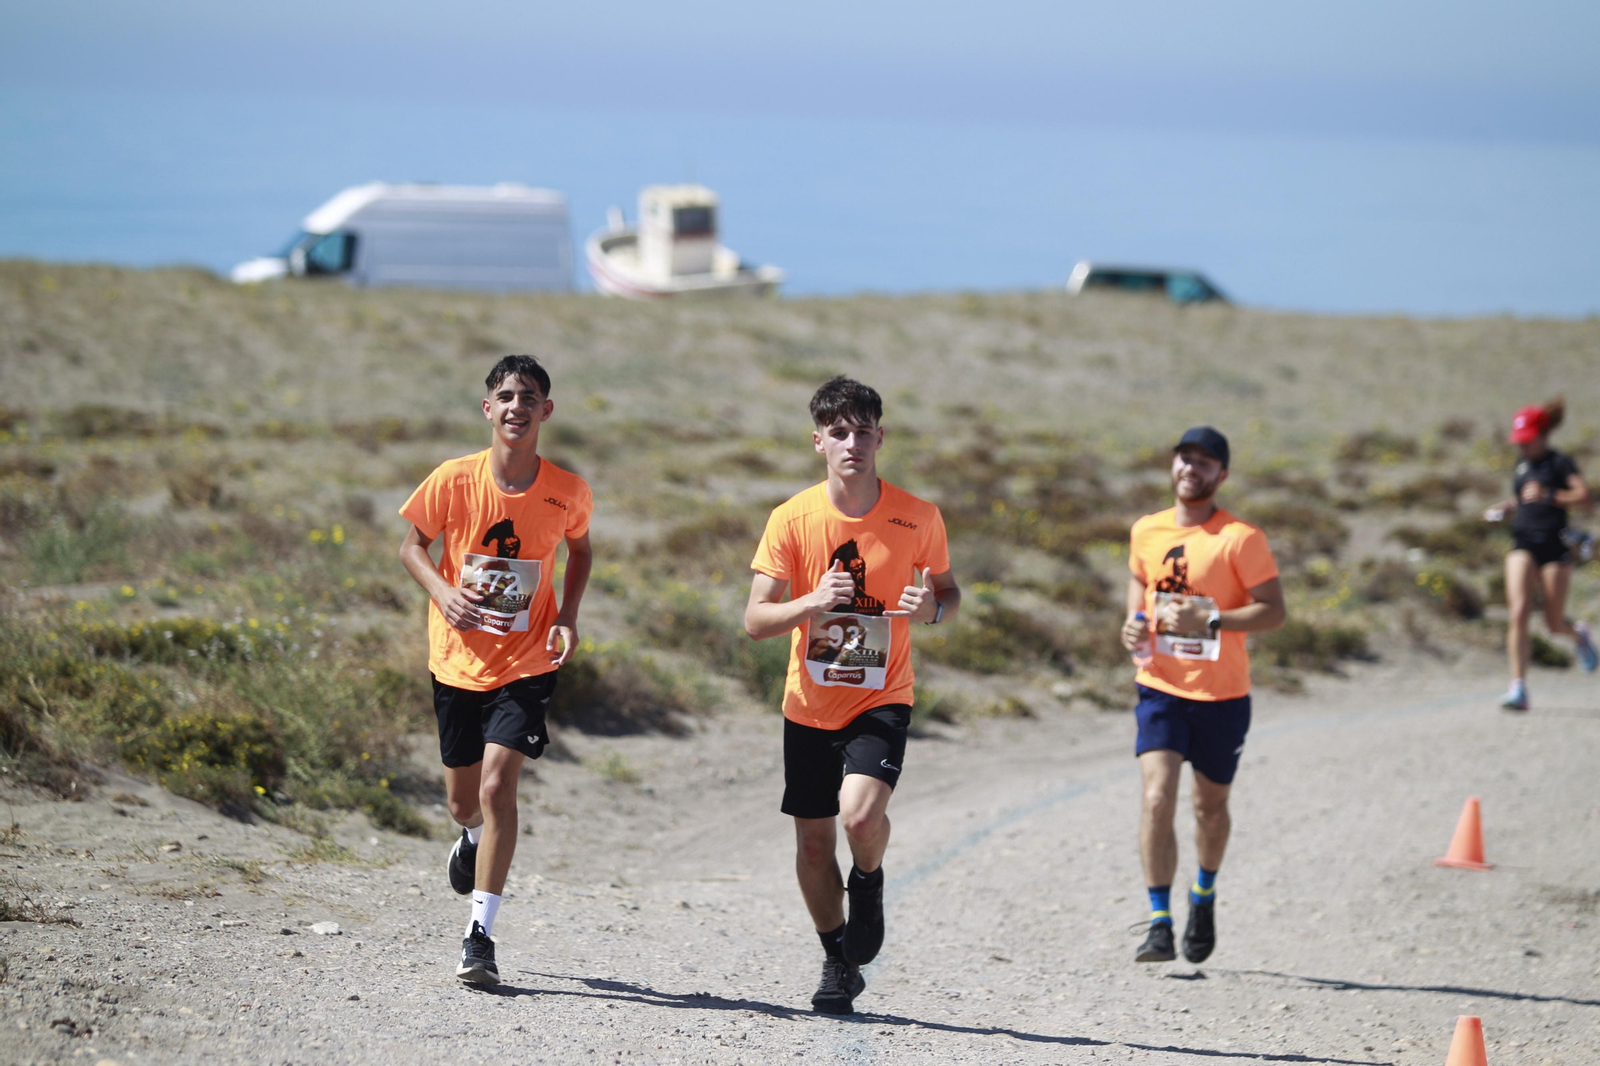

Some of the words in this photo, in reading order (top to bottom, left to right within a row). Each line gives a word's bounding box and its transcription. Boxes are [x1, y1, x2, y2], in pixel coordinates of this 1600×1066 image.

[473, 567, 520, 597] 172
[855, 597, 878, 607] XIII
[827, 624, 860, 650] 93
